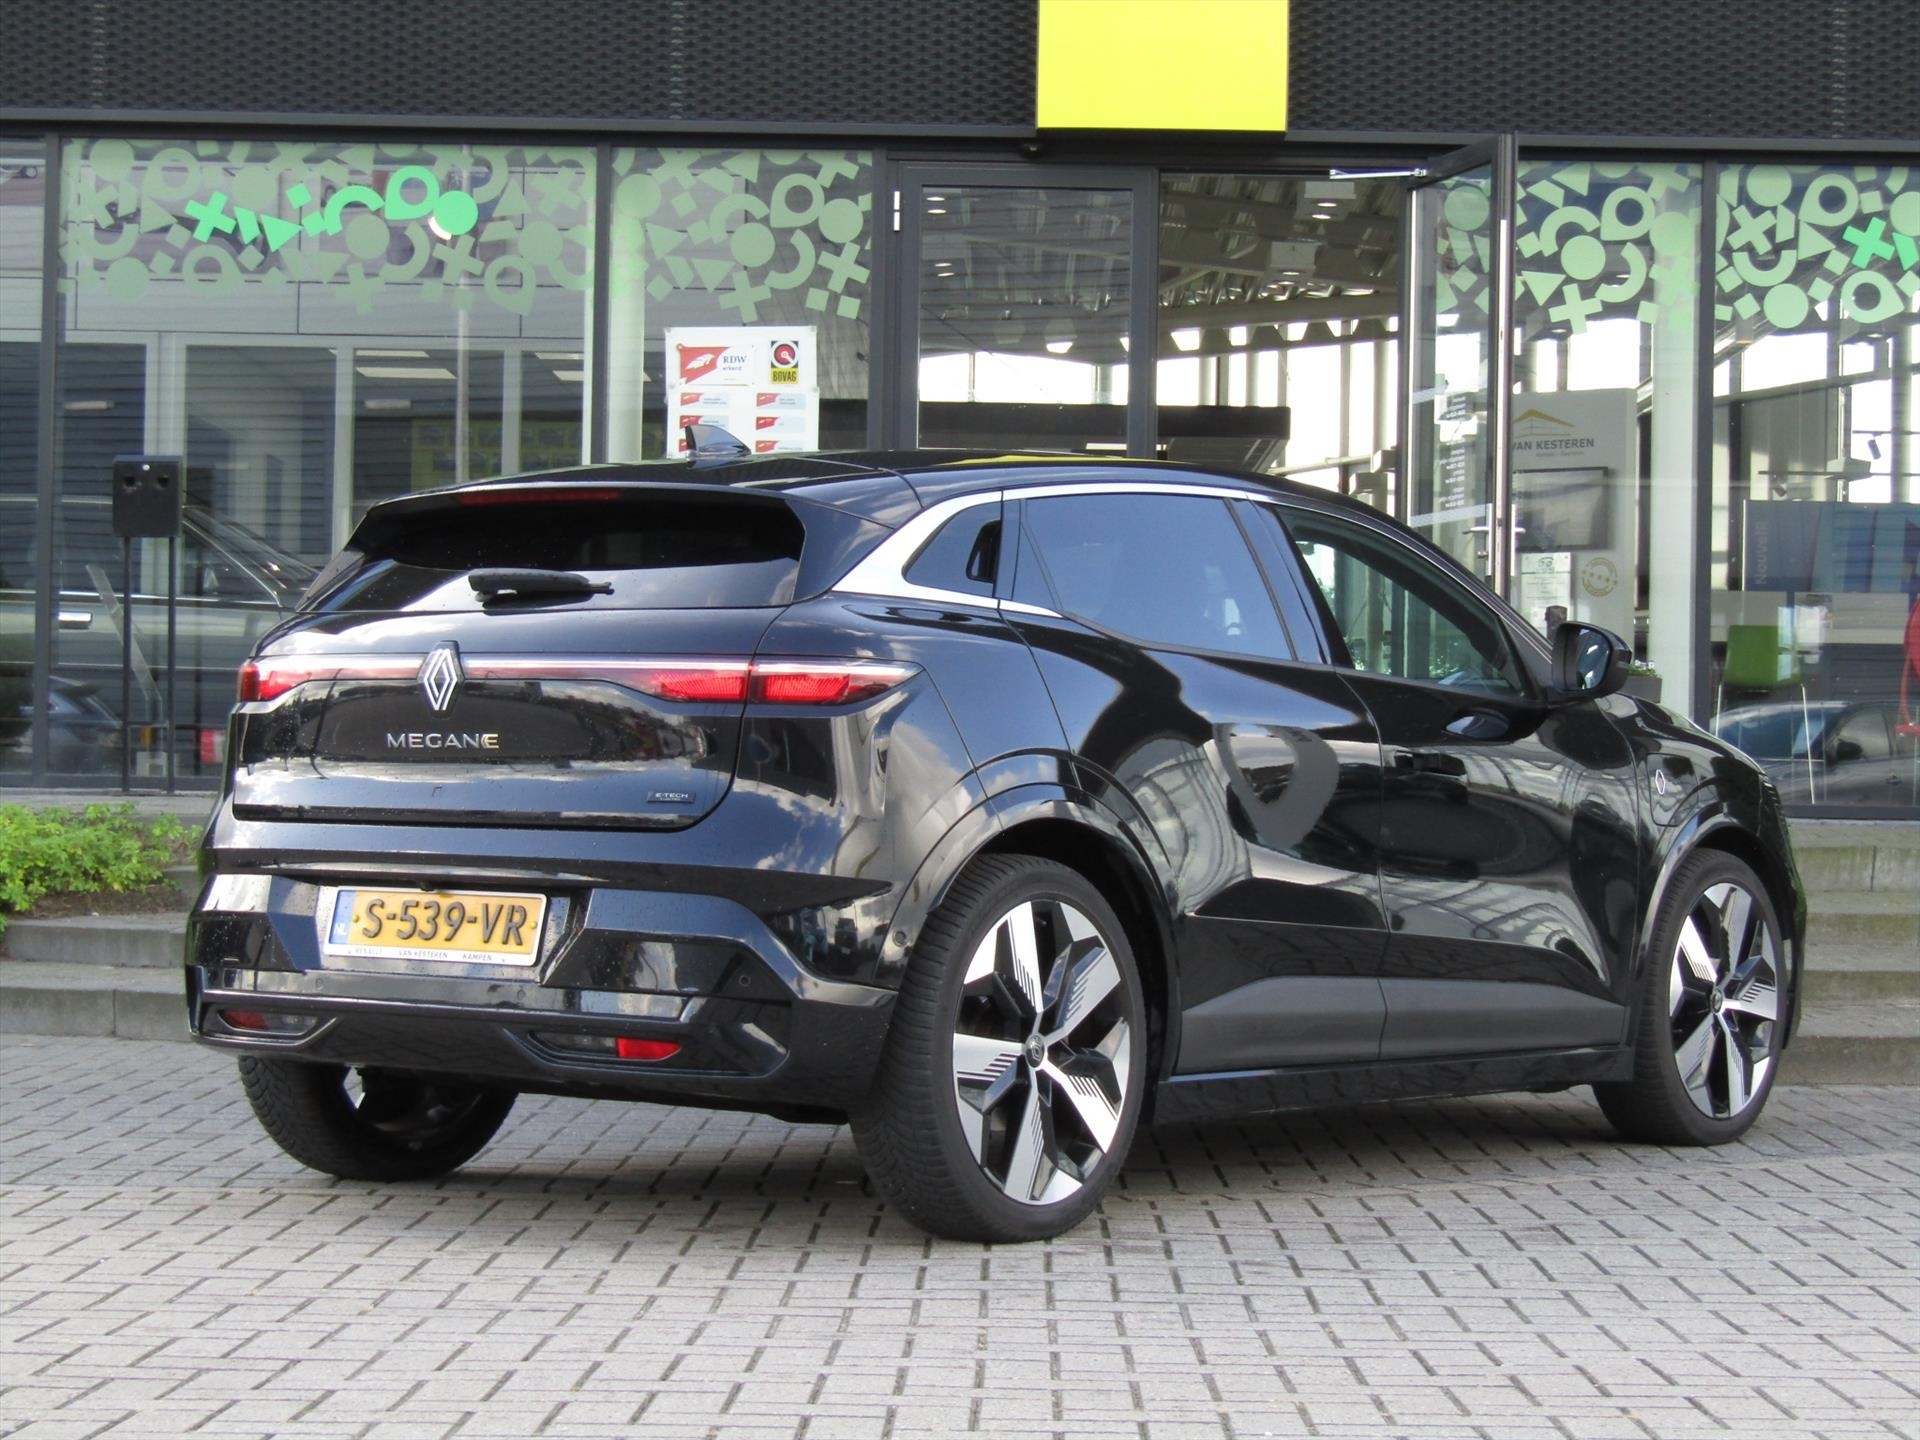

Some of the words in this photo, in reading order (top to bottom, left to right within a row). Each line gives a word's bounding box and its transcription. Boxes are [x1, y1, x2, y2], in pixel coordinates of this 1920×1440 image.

[723, 355, 747, 364] RDW
[772, 370, 797, 382] BOVAG
[1536, 438, 1594, 450] KESTEREN
[387, 733, 499, 749] MEGANE
[362, 897, 528, 946] S-539-VR
[462, 953, 493, 961] KAMPEN
